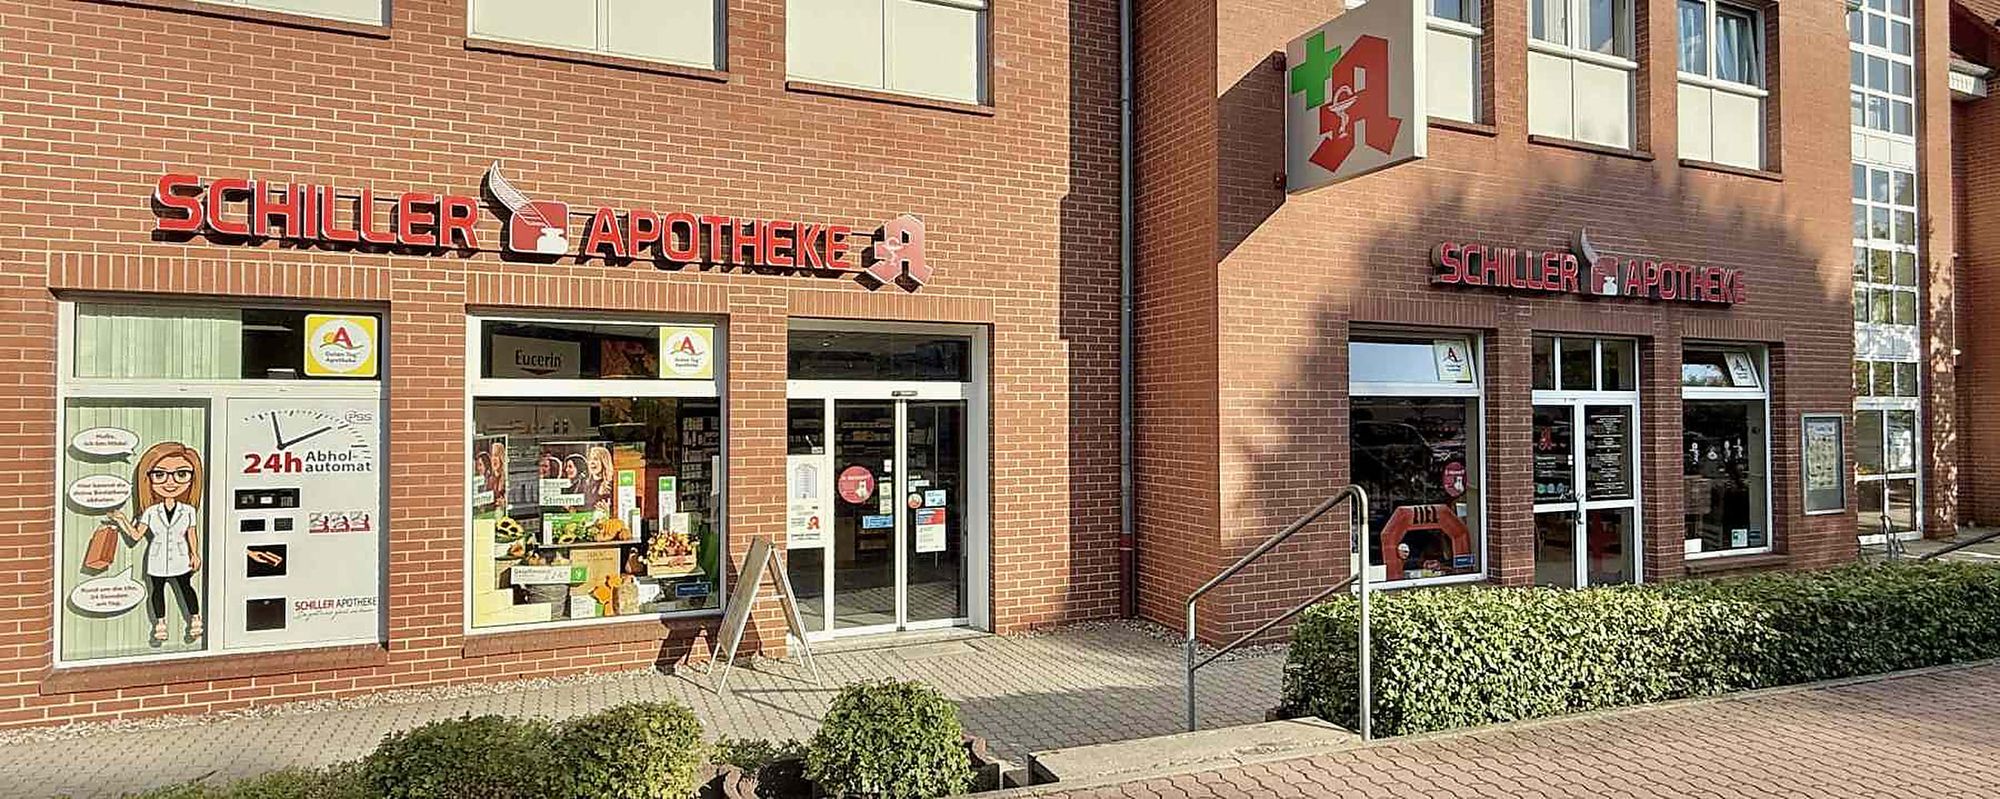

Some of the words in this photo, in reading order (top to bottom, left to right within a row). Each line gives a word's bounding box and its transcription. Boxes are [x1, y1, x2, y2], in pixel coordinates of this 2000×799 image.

[154, 173, 480, 249] SCHILLER
[584, 206, 852, 270] APOTHEKE
[1437, 241, 1579, 293] SCHILLER
[1624, 258, 1746, 305] APOTHEKE
[515, 349, 562, 367] Eucerin
[243, 452, 302, 473] 24h
[305, 450, 358, 462] Abhol-
[305, 461, 372, 473] automat
[543, 495, 582, 505] Stimme
[295, 600, 334, 611] SCHILLER
[336, 597, 377, 608] APOTHEKE
